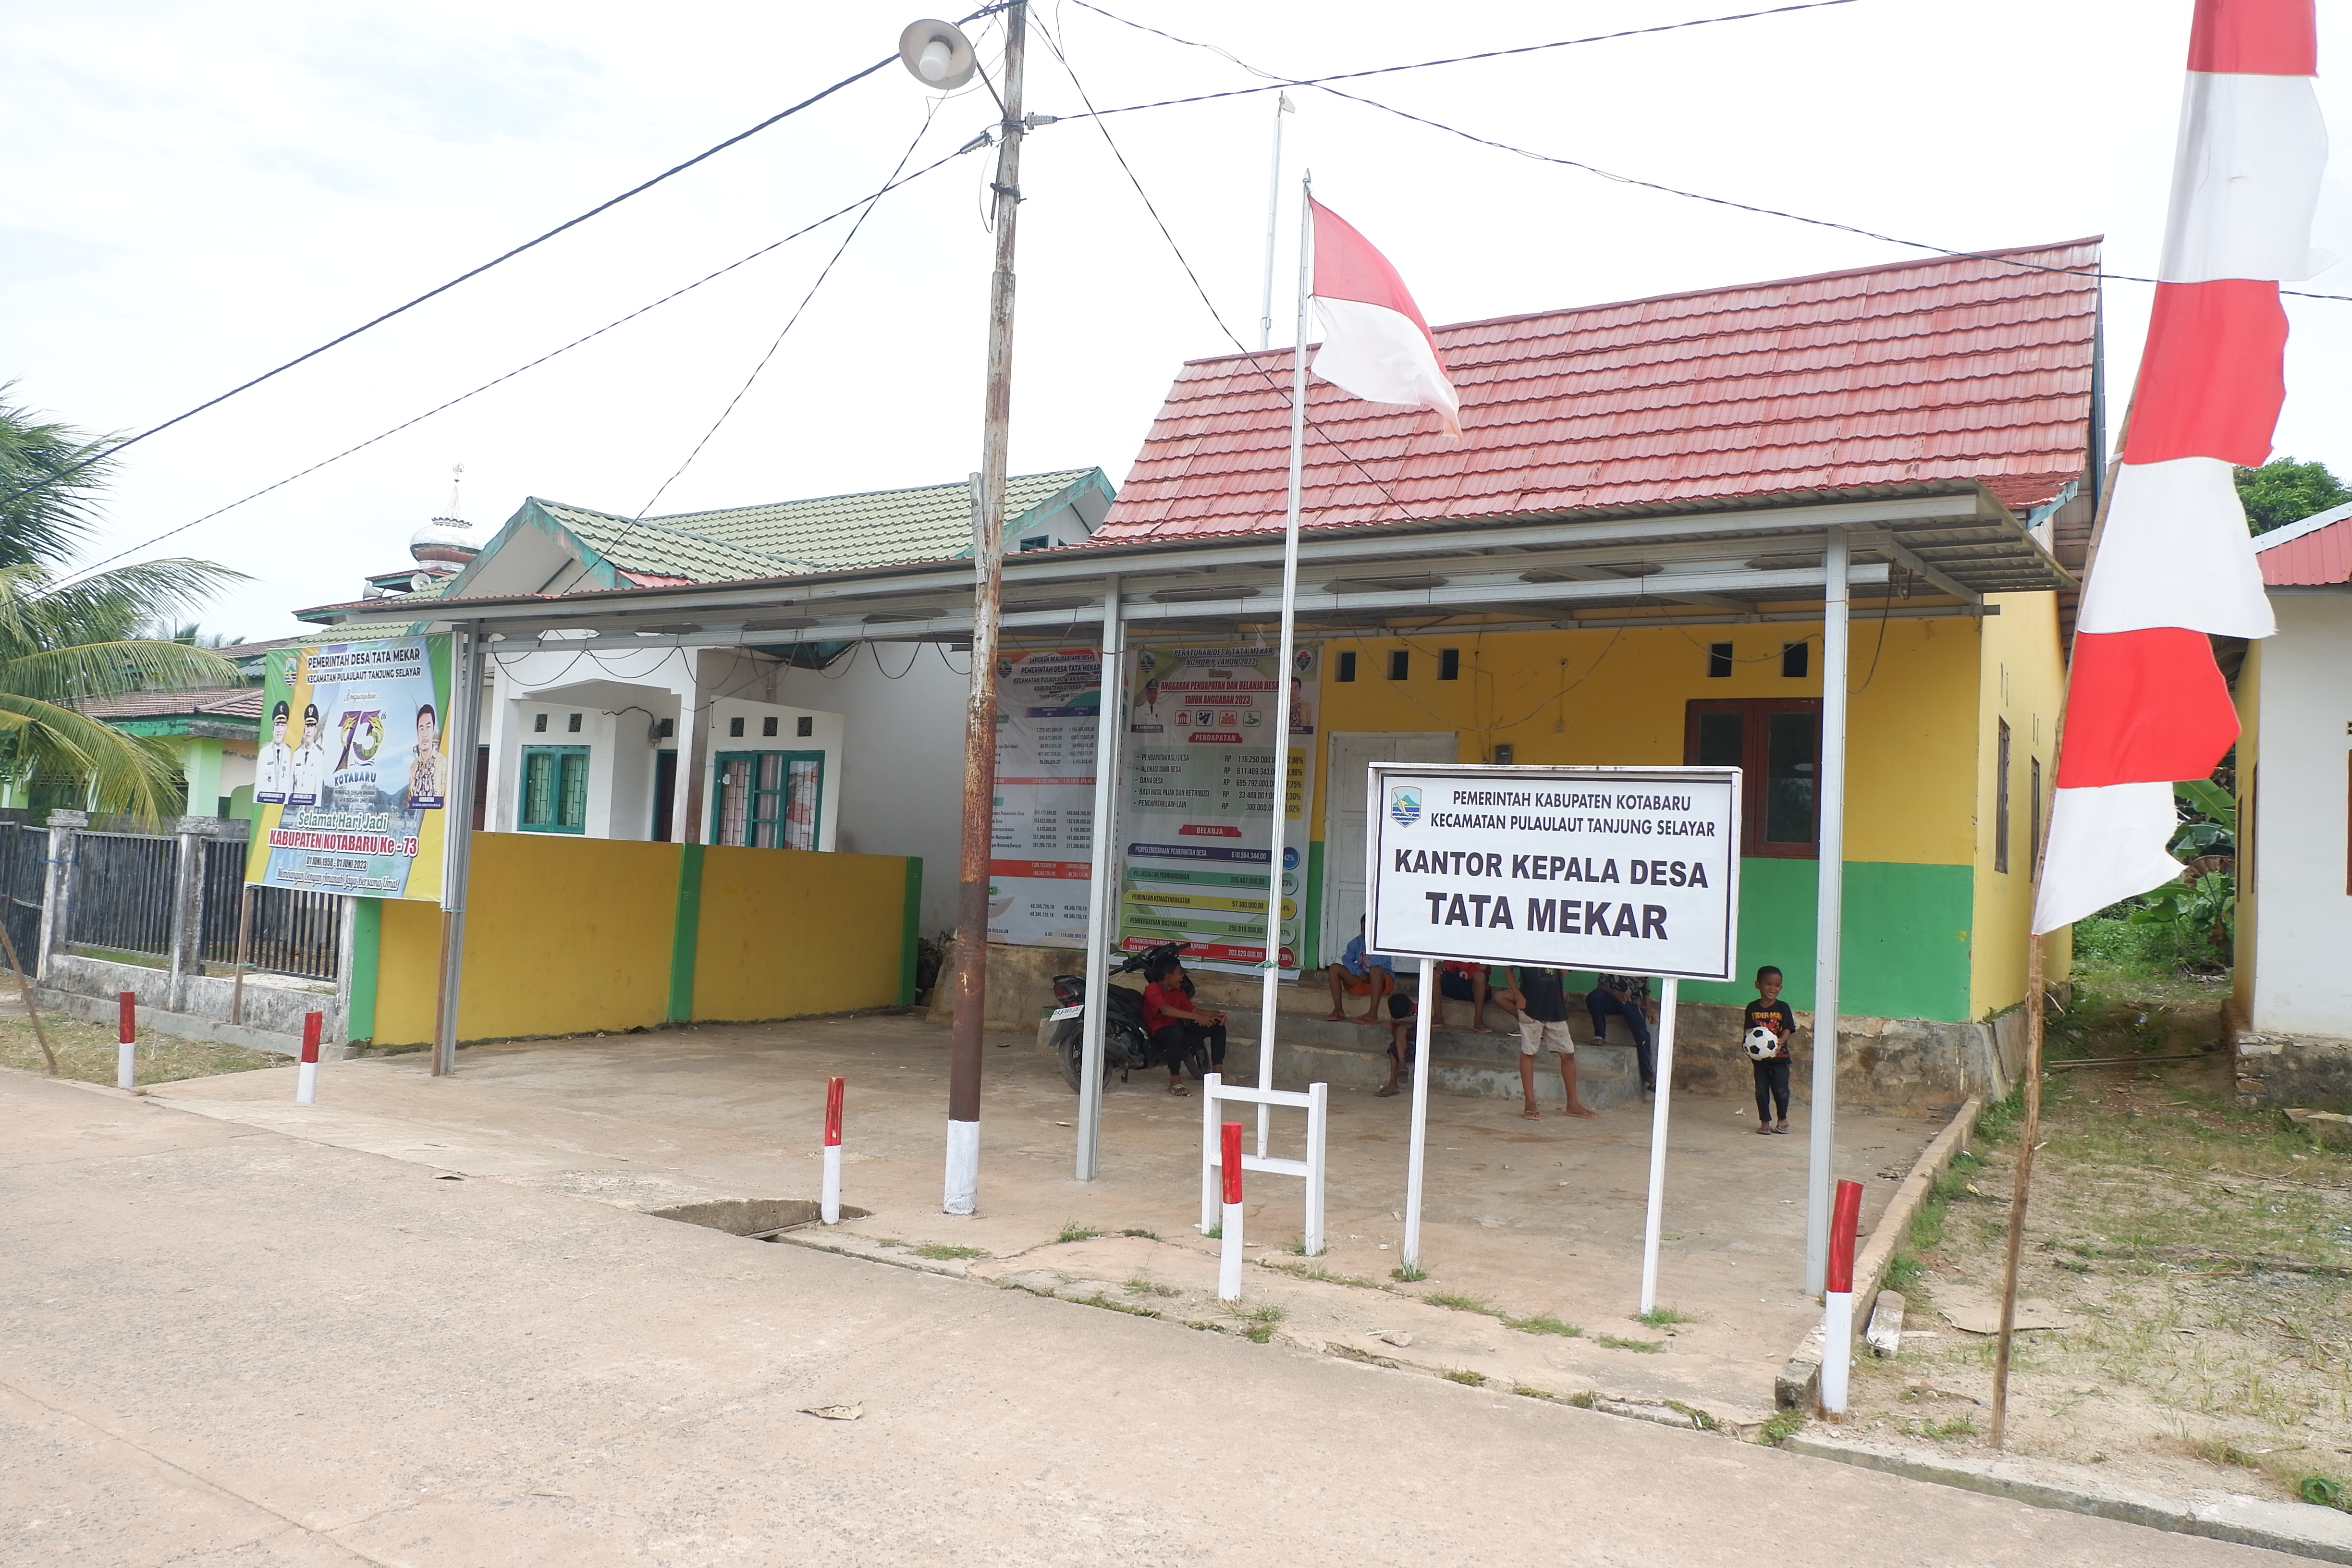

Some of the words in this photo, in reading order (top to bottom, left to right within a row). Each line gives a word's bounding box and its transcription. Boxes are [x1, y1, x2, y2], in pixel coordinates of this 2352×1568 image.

[308, 654, 349, 668] PEMERINTAH
[351, 652, 370, 664] DESA
[372, 651, 391, 663] TATA
[393, 649, 420, 662] MEKAR
[307, 673, 336, 683] KECAMATAN
[337, 671, 367, 682] PULAULAUT
[368, 669, 394, 679] TANJUNG
[396, 667, 421, 677] SELAYAR
[1021, 665, 1053, 674] PEMERINTAH
[1161, 682, 1189, 690] ANGGARAN
[1191, 682, 1225, 690] PENDAPATAN
[1226, 682, 1237, 690] DAN
[1239, 681, 1263, 690] BELANJA
[1185, 696, 1202, 704] TAHUN
[1203, 696, 1234, 704] ANGGARAN
[335, 772, 376, 786] KOTABARU
[1453, 791, 1531, 807] PEMERINTAH
[1535, 793, 1611, 809] KABUPATEN
[1616, 795, 1691, 811] KOTABARU
[298, 812, 336, 828] Selamat
[339, 813, 361, 828] Hari
[364, 815, 388, 830] Jadi
[1431, 813, 1506, 830] KECAMATAN
[1510, 816, 1584, 833] PULAULAUT
[1588, 818, 1652, 835] TANJUNG
[1656, 820, 1715, 837] SELAYAR
[270, 830, 323, 848] KABUPATEN
[324, 834, 378, 852] KOTABARU
[380, 837, 394, 853] Ke
[404, 838, 417, 854] 73
[306, 856, 311, 865] 01
[312, 857, 321, 865] JUNI
[322, 858, 333, 866] 1950
[337, 858, 342, 867] 01
[343, 859, 353, 868] JUNI
[354, 860, 367, 869] 2023
[1232, 851, 1266, 860] 610.564.344,00
[1395, 849, 1502, 878] KANTOR
[1512, 854, 1619, 884] KEPALA
[1630, 859, 1709, 889] DESA
[1231, 877, 1264, 885] 335.487.000,00
[1154, 895, 1190, 904] KEMASYARAKATAN
[1232, 901, 1263, 909] 57.300.000,00
[1425, 892, 1514, 930] TATA
[1527, 898, 1668, 941] MEKAR
[1130, 917, 1160, 925] PEMBERDAYAAN
[1229, 925, 1262, 933] 250.919.000,00
[1228, 949, 1262, 958] 203.029.000,00
